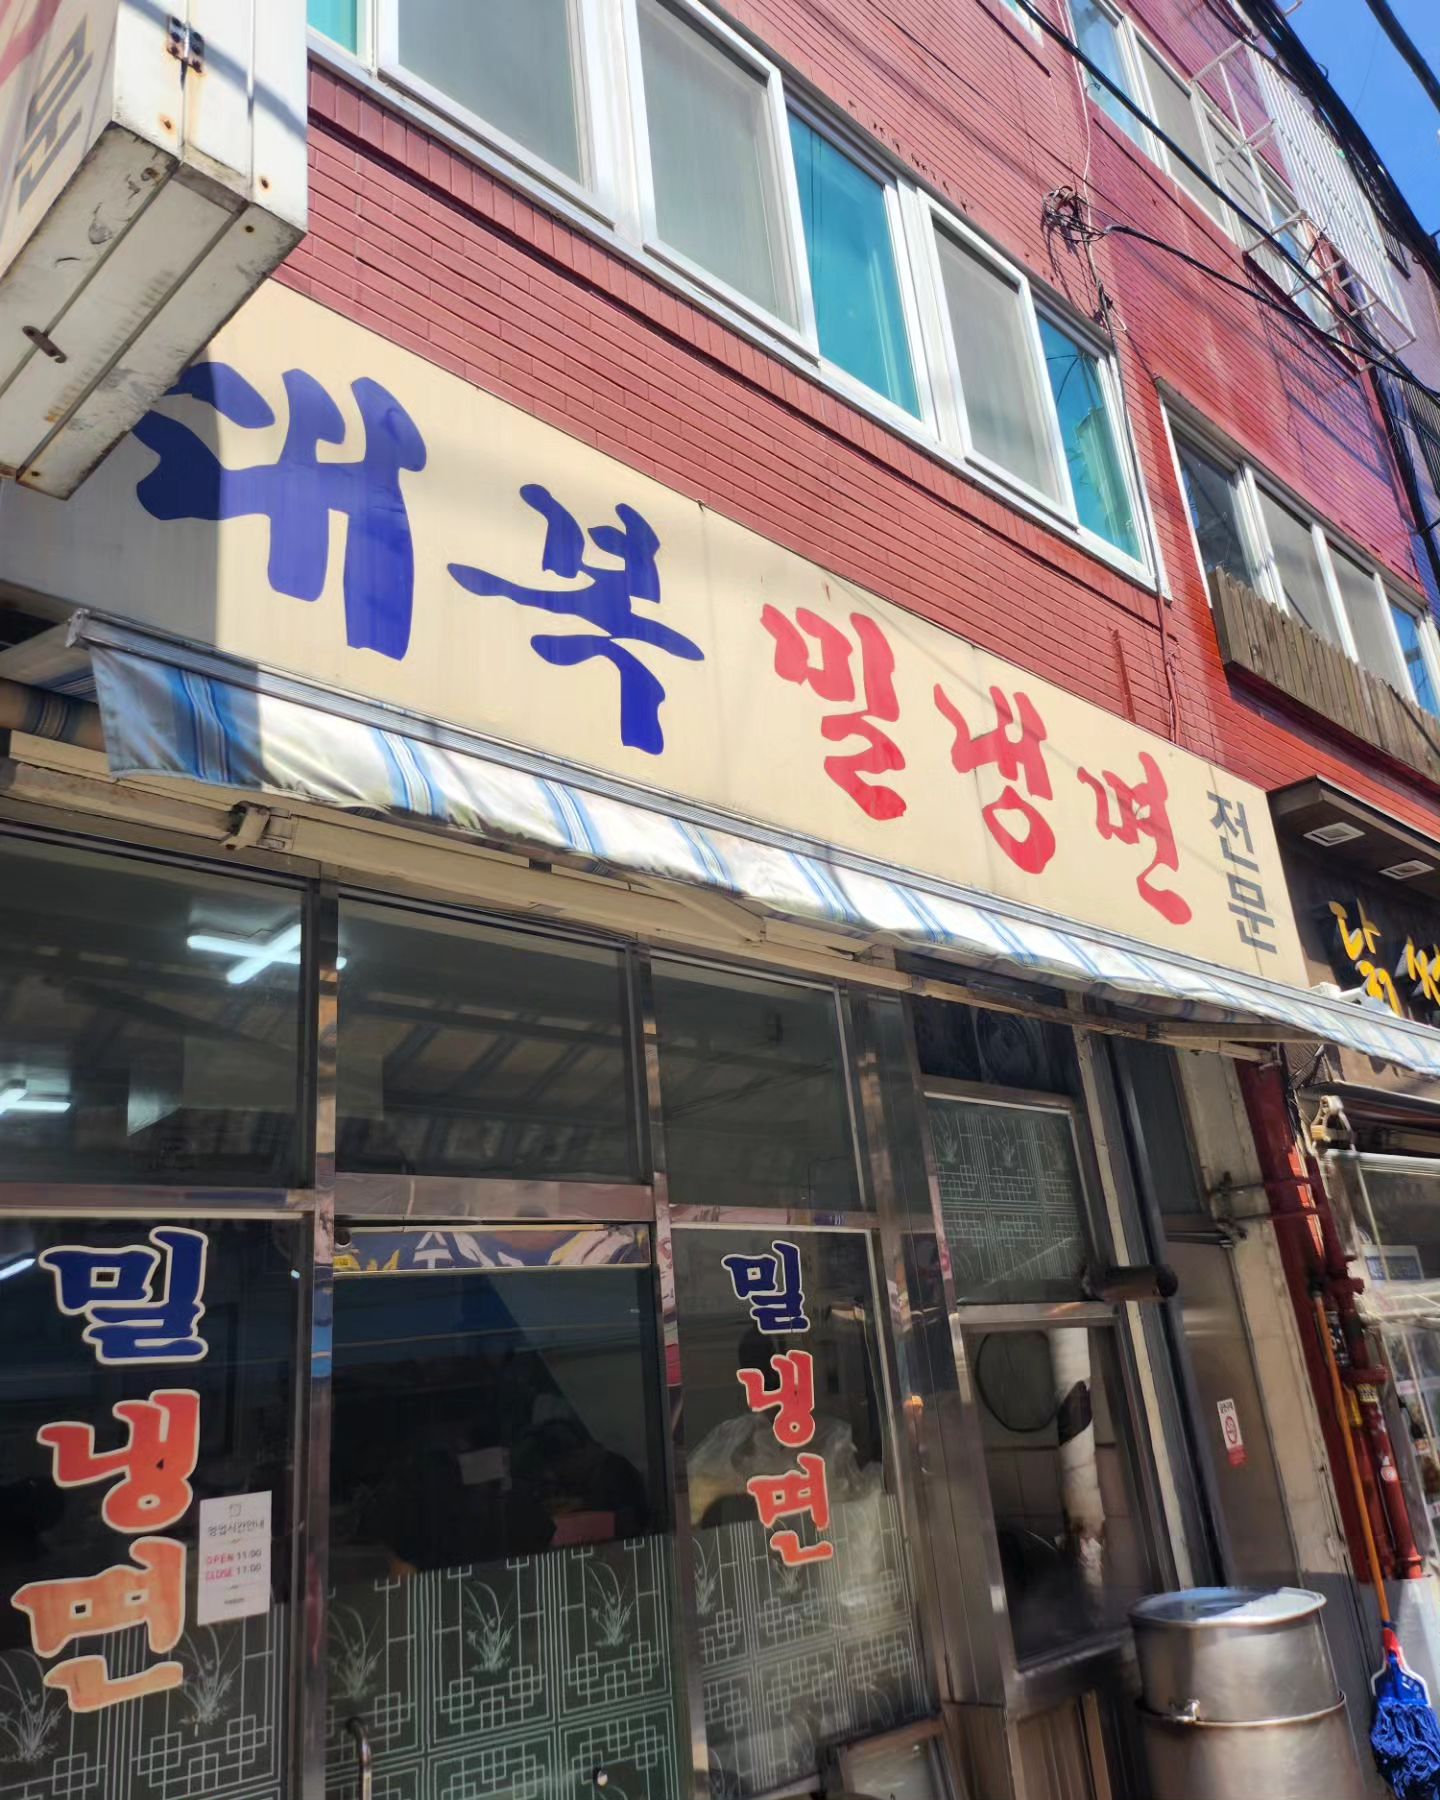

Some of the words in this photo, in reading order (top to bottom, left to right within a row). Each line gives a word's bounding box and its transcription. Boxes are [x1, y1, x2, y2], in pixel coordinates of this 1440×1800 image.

[760, 603, 1192, 925] 밀냉면
[1206, 790, 1278, 954] 전문
[10, 1225, 209, 1713] 밀냉면
[721, 1239, 833, 1566] 밀냉면
